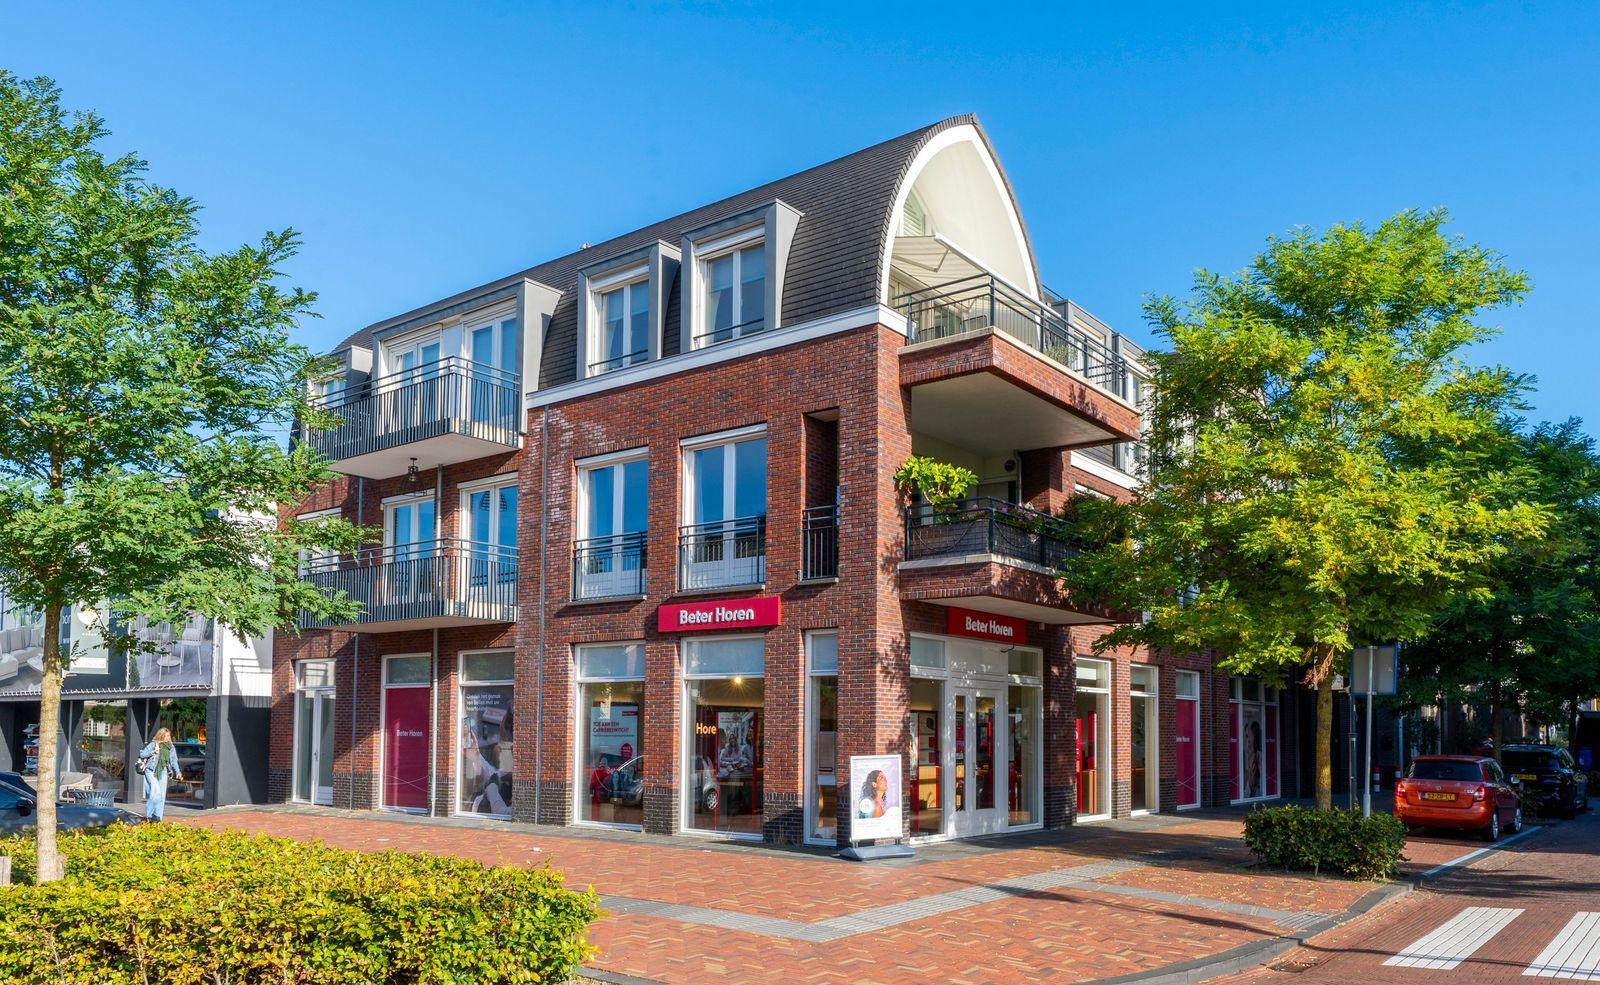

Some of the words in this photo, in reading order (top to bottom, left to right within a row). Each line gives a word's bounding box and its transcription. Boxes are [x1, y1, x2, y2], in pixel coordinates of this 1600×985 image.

[679, 609, 713, 625] Beter
[715, 606, 755, 622] Horen
[965, 615, 988, 633] Beter
[989, 619, 1013, 637] Horen
[396, 729, 408, 737] Beter
[409, 729, 423, 737] Horen
